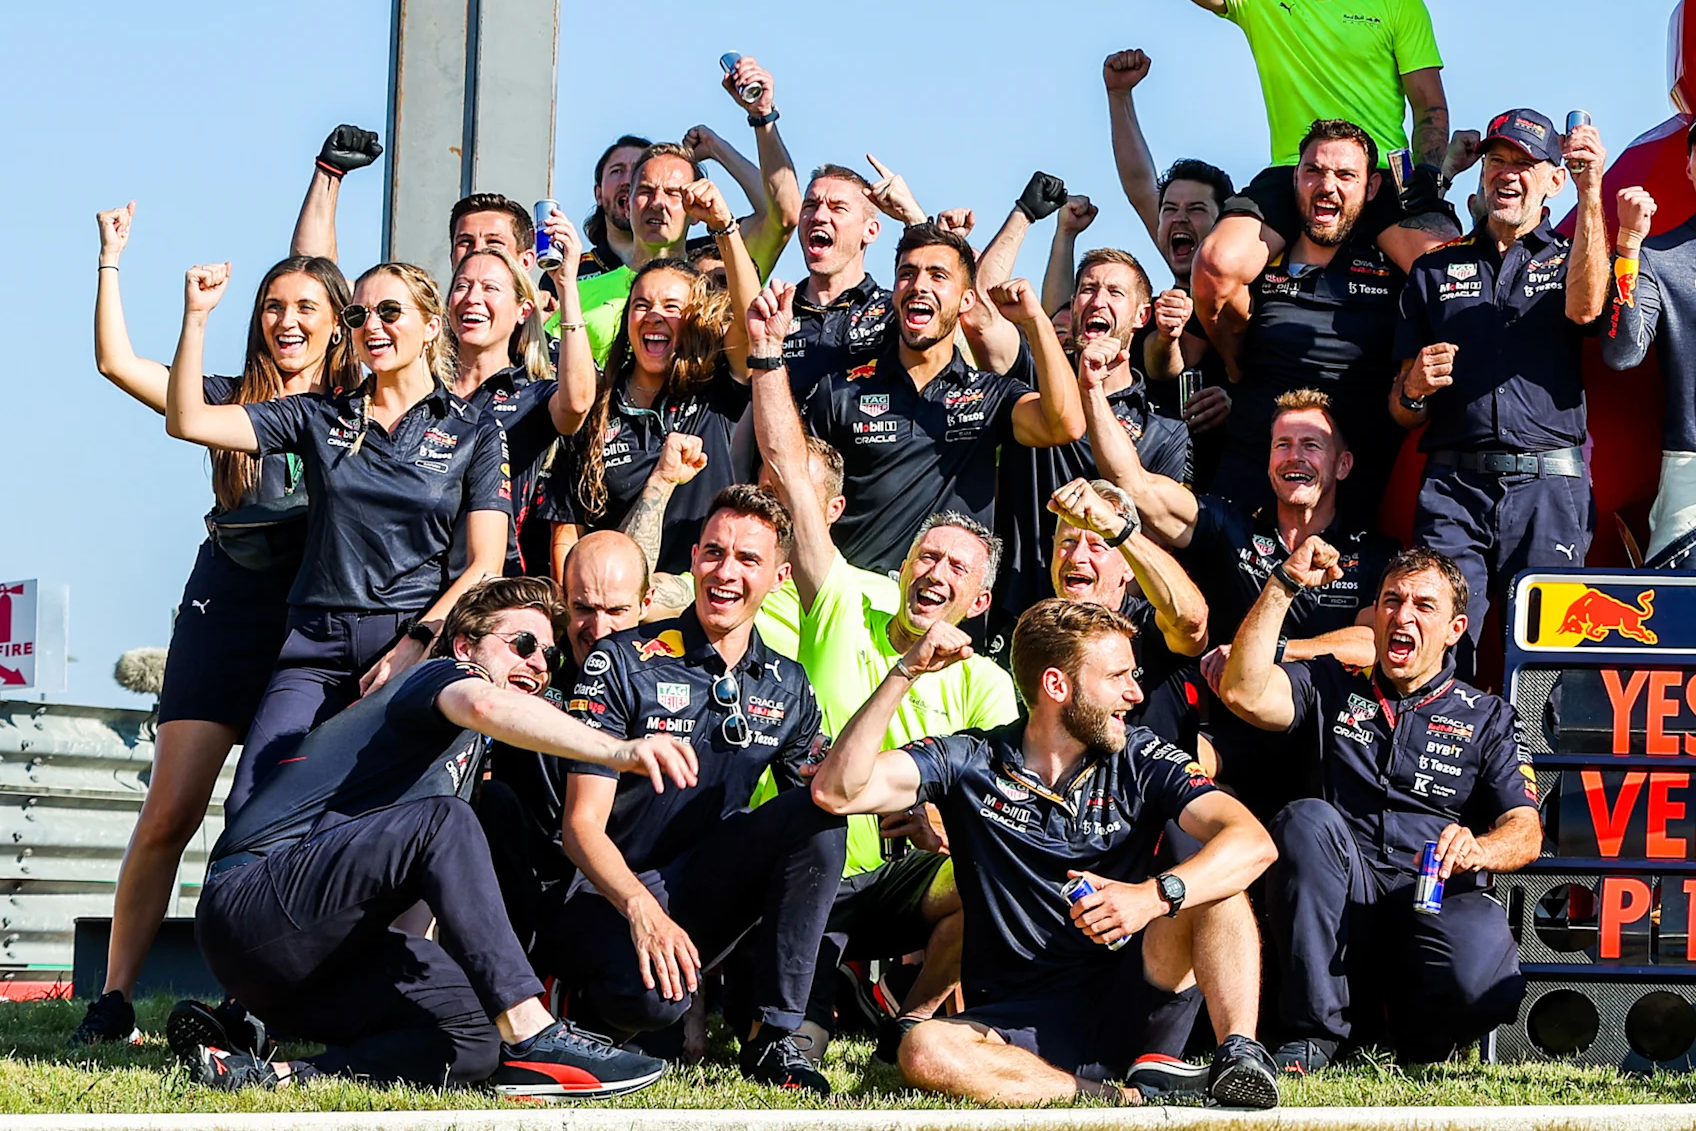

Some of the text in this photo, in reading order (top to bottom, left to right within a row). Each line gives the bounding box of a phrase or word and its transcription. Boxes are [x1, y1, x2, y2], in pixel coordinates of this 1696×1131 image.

[1359, 284, 1389, 295] Tezos
[1440, 291, 1480, 301] ORACLE
[863, 395, 888, 405] TAG
[958, 411, 985, 423] Tezos
[853, 421, 885, 433] Mobil
[855, 434, 897, 445] ORACLE
[605, 454, 633, 469] ACLE
[1253, 535, 1274, 547] TAG
[544, 688, 562, 701] AG
[660, 685, 688, 697] TAG
[748, 695, 785, 710] ORACLE
[1352, 696, 1378, 710] TAG
[646, 716, 682, 732] Mobil
[1430, 714, 1475, 731] ORACLE
[754, 730, 780, 747] Tezos
[1426, 730, 1471, 743] RACING
[1426, 741, 1464, 758] BYBIT
[1430, 759, 1463, 777] Tezos
[983, 793, 1018, 817] Mobil
[980, 808, 1027, 833] ORACLE
[1094, 820, 1121, 836] Teos
